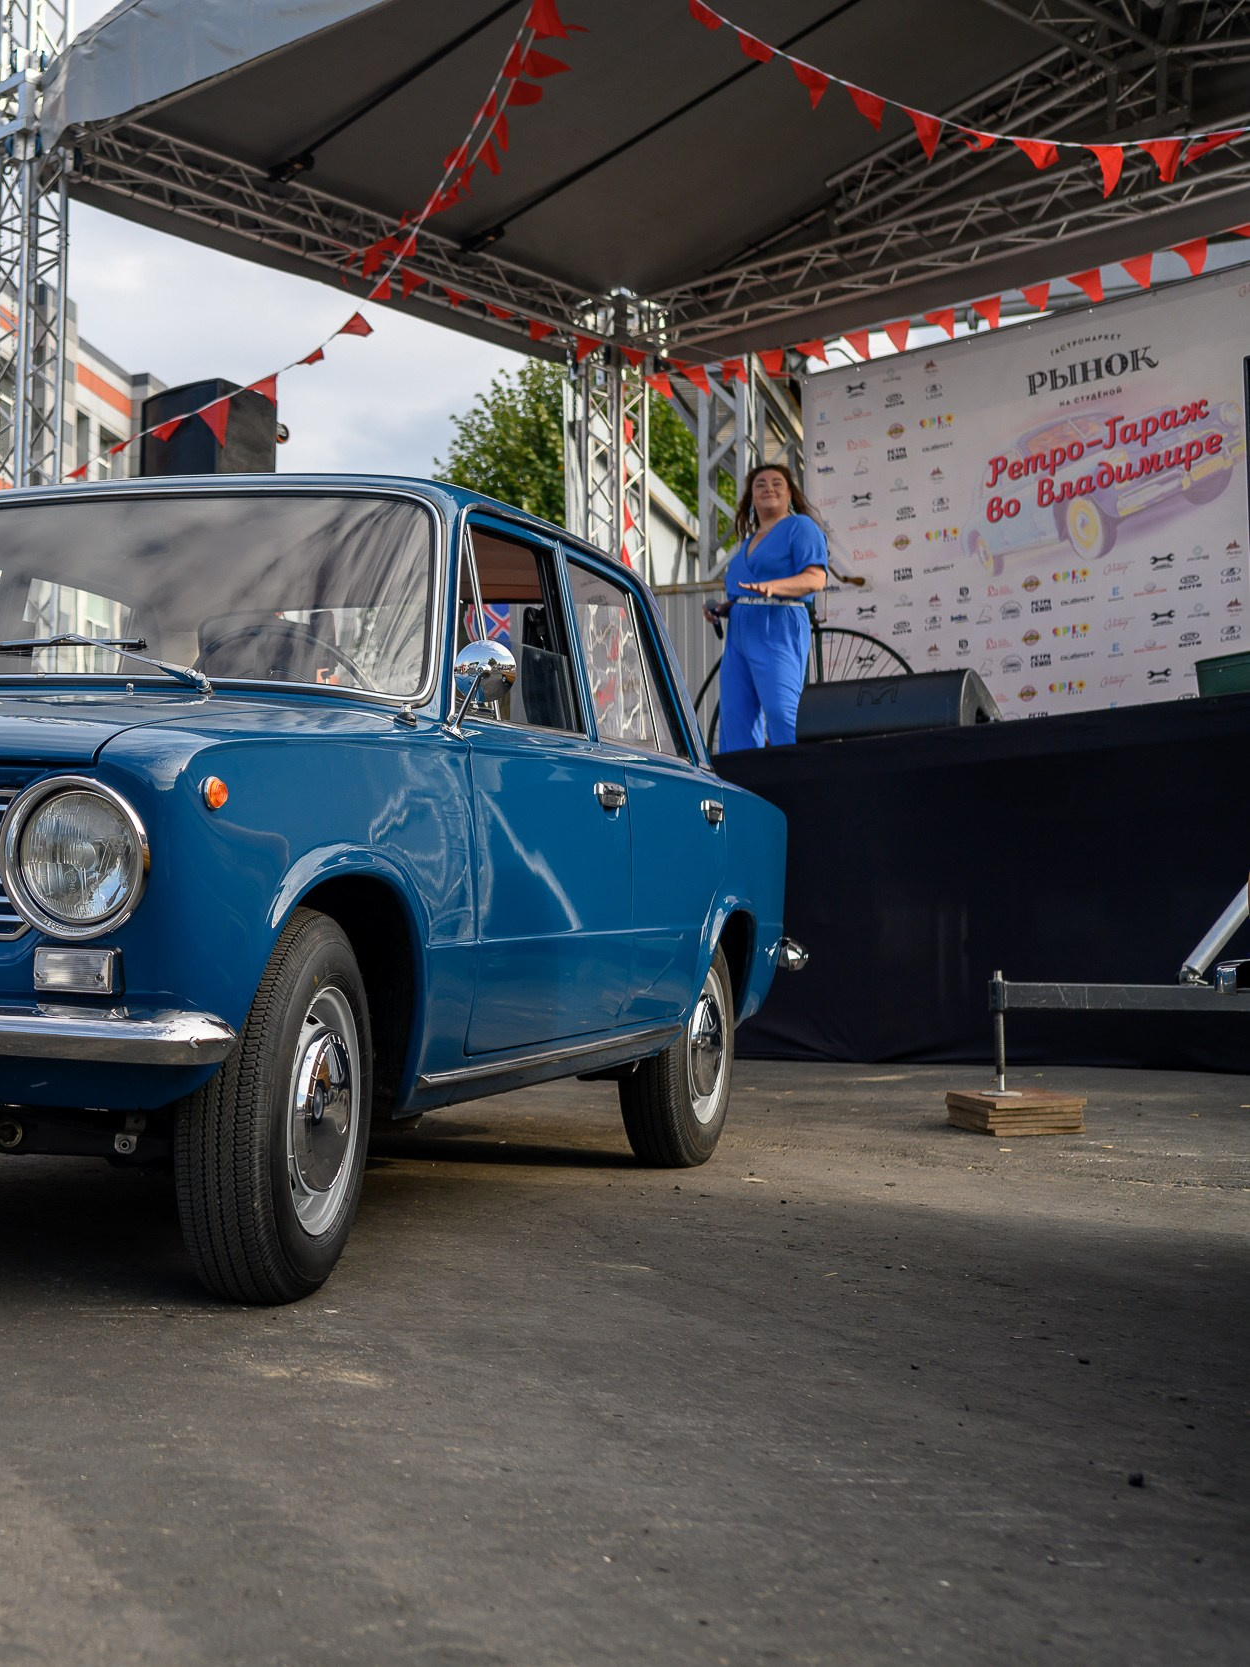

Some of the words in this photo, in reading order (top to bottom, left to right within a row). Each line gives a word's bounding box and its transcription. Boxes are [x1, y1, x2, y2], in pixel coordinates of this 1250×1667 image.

[1026, 345, 1160, 397] РЫНОК
[1050, 333, 1122, 357] ГАСТРОМАРКЕТ
[1059, 399, 1071, 407] НА
[1074, 386, 1123, 405] СТУДЁНОЙ
[986, 398, 1210, 488] Ретро-Гараж
[986, 496, 1021, 524] во
[1037, 433, 1223, 508] Владимире
